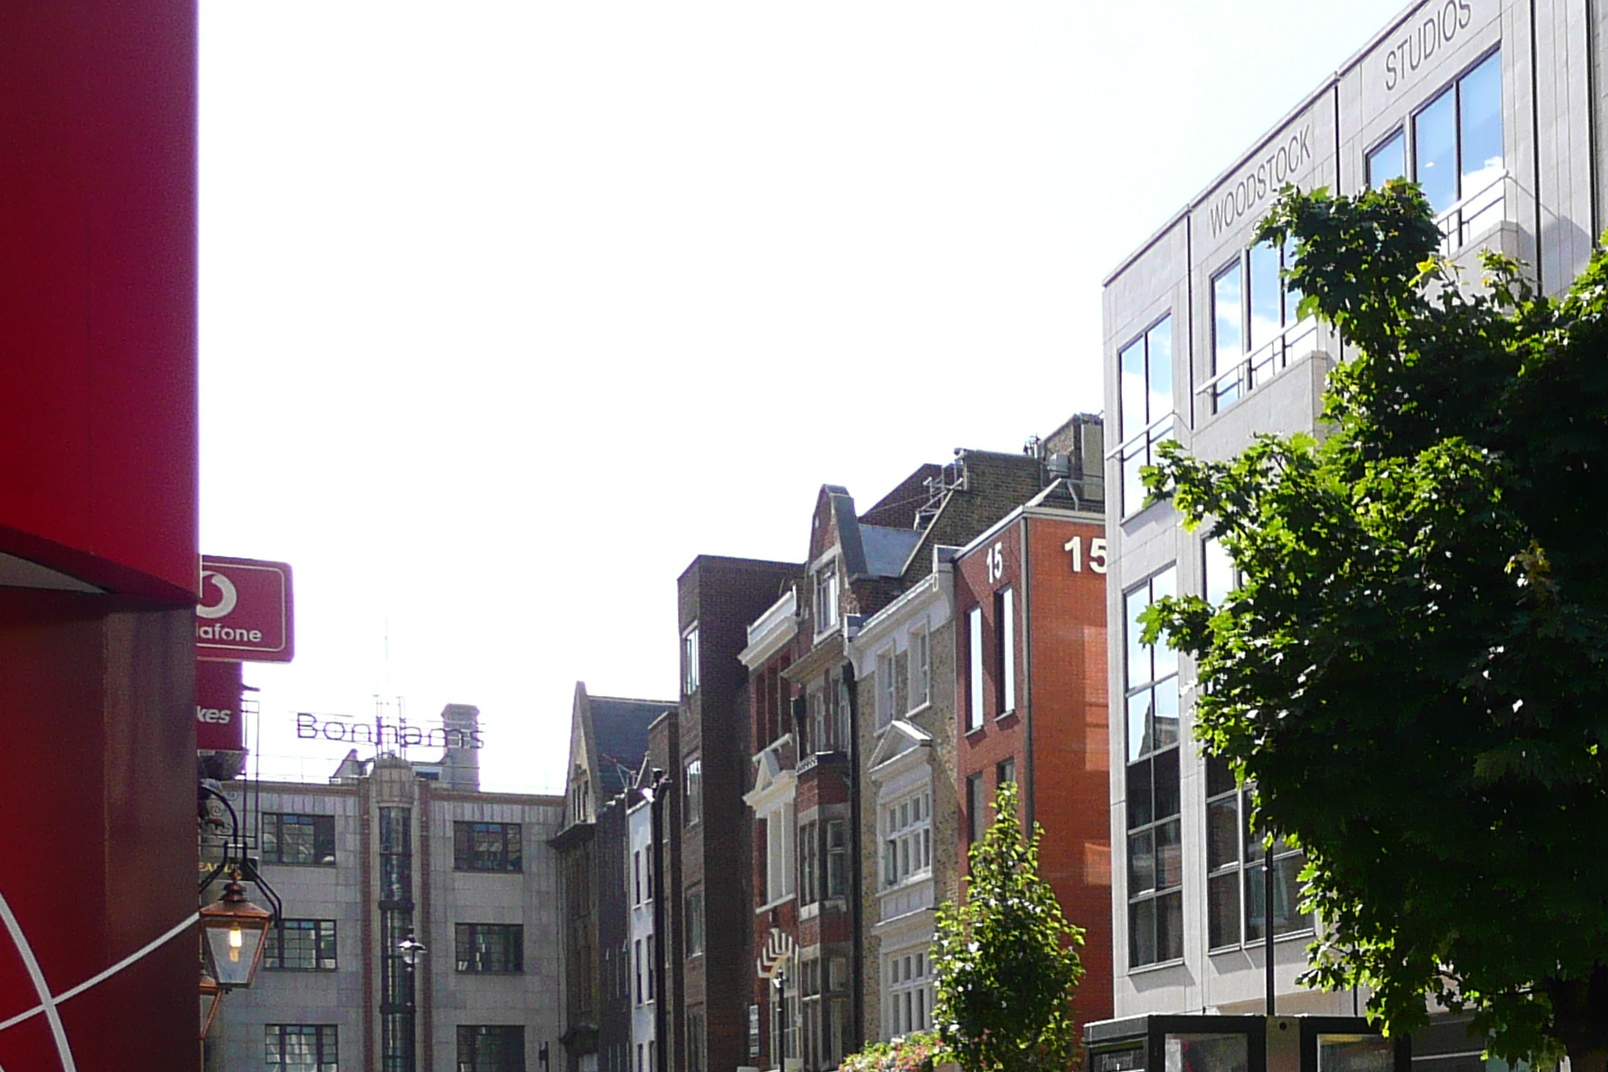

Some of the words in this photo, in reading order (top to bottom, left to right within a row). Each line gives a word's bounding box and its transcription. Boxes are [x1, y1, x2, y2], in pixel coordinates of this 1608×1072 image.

[1209, 124, 1311, 239] WOODSTOCK
[1385, 0, 1471, 91] STUDIOS
[986, 541, 1004, 584] 15
[1064, 535, 1108, 574] 15
[196, 623, 263, 643] afone
[297, 712, 484, 749] Bonhams
